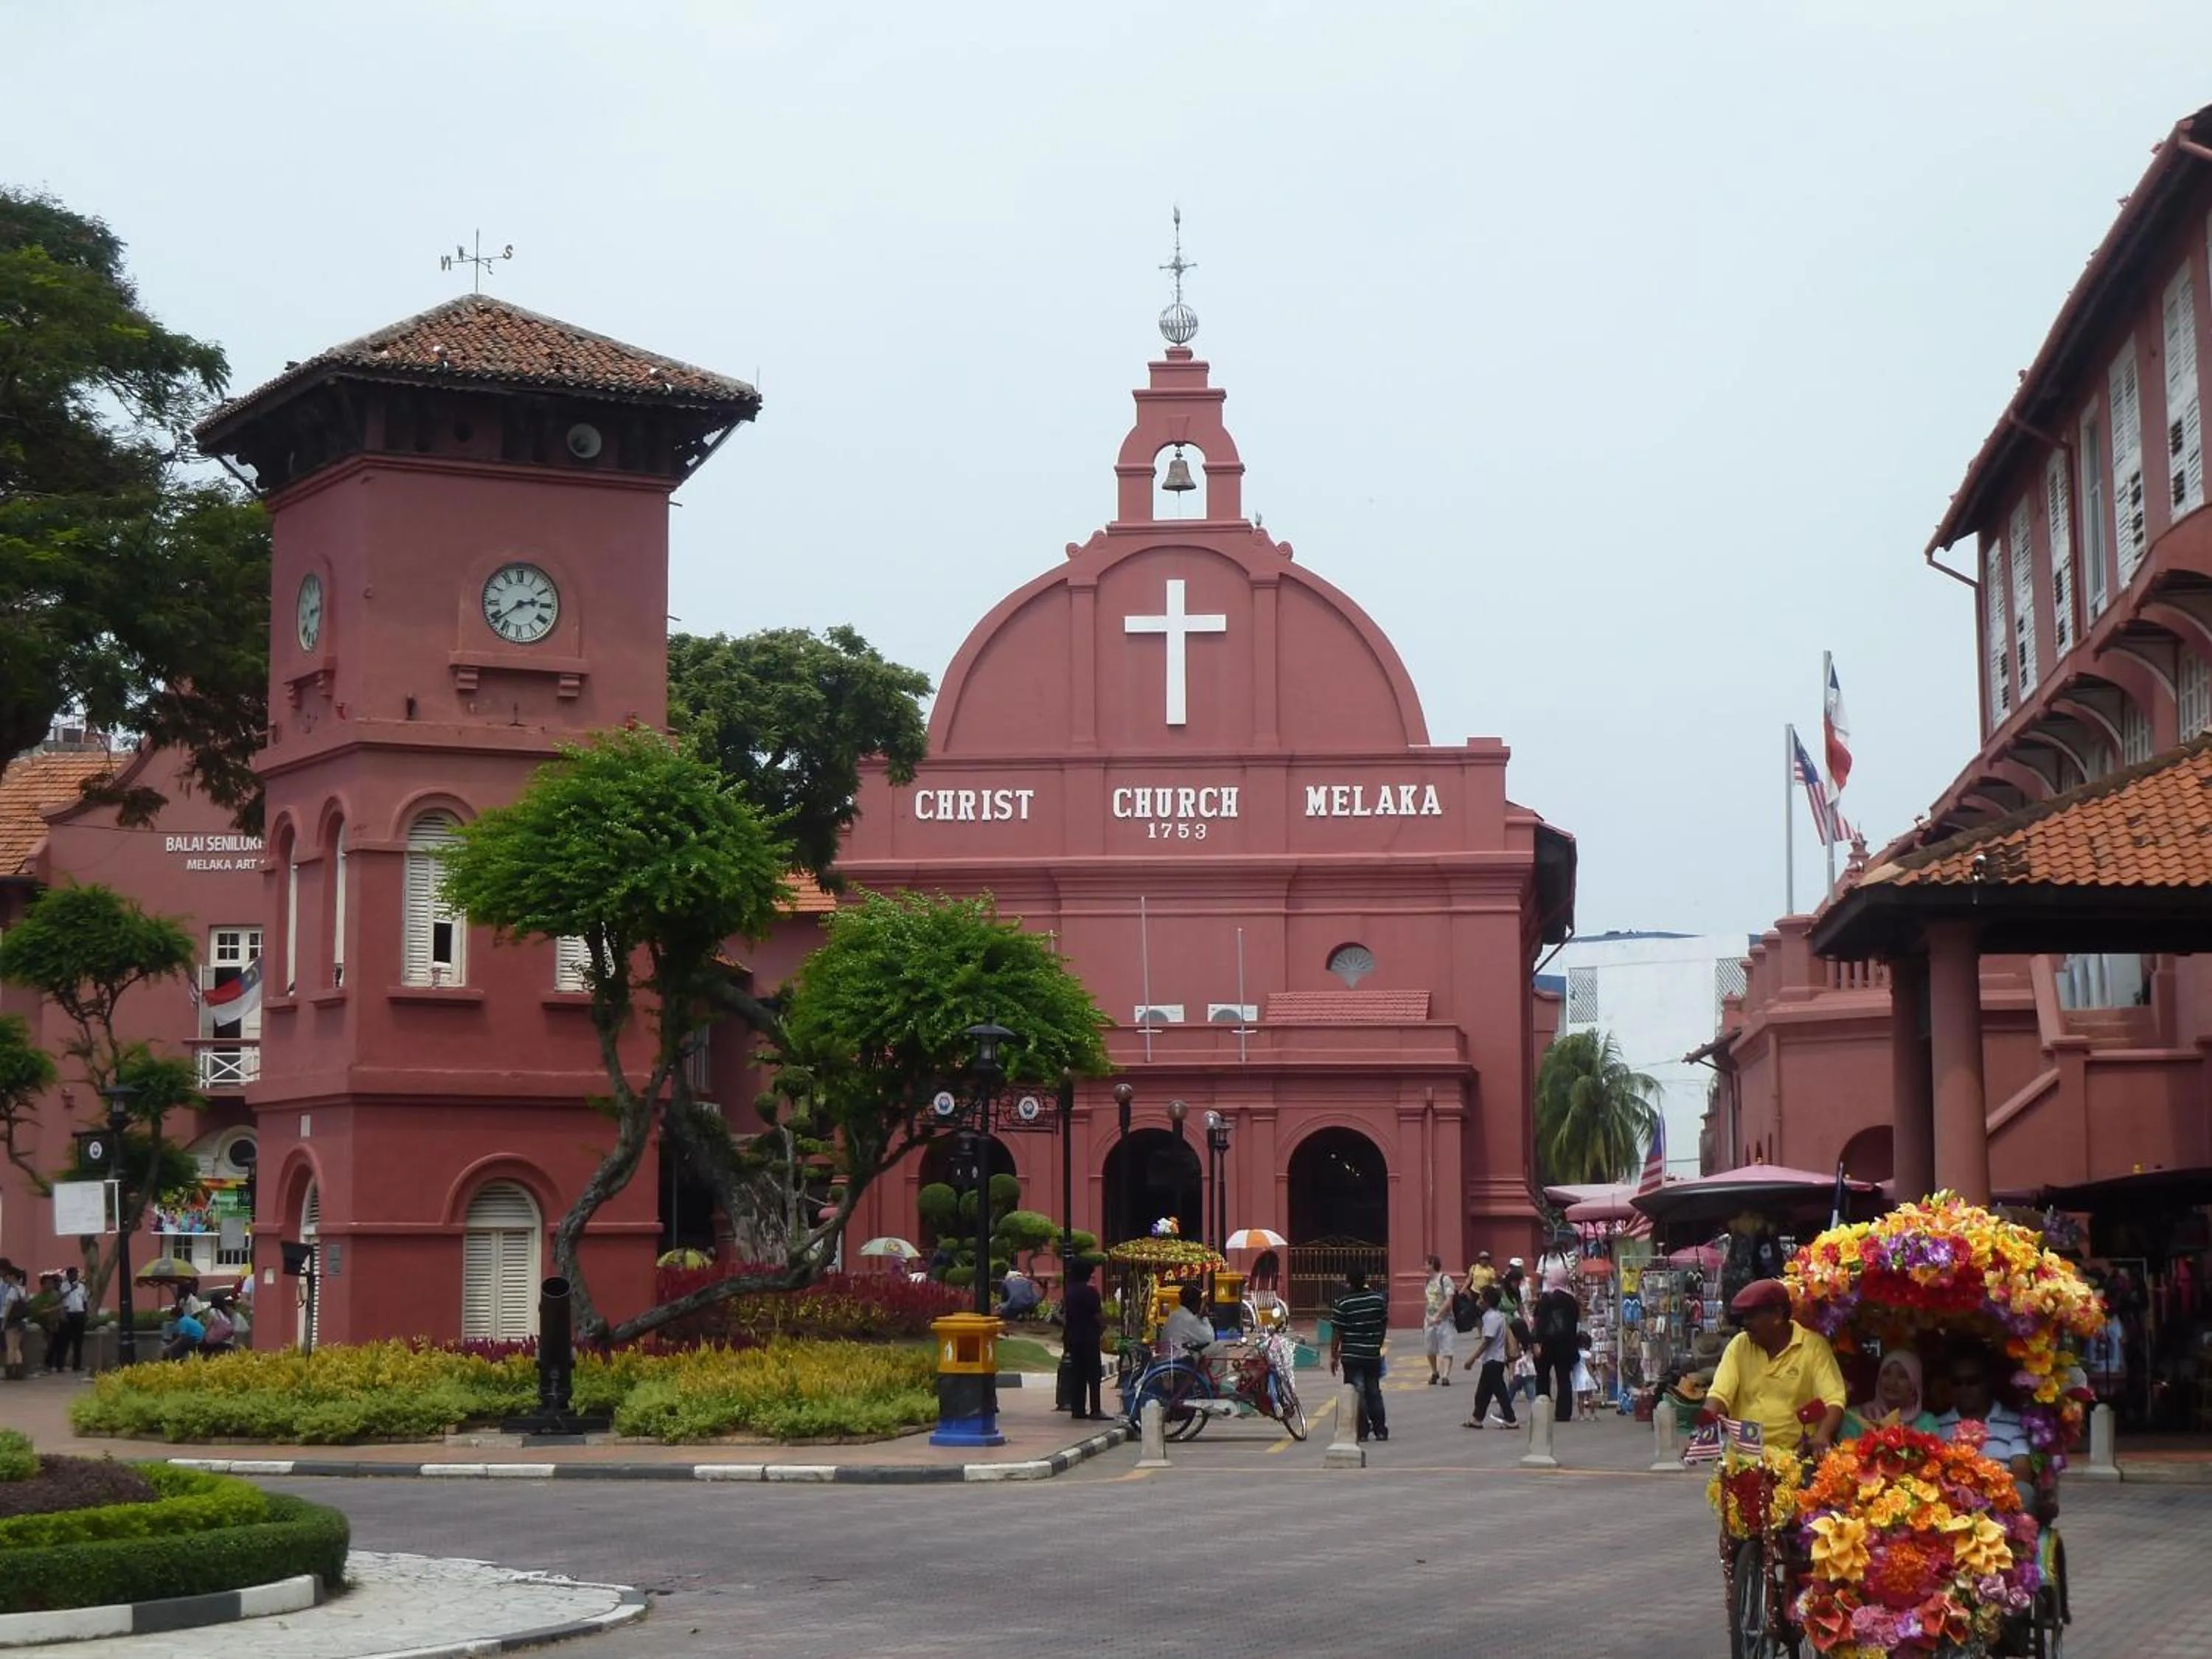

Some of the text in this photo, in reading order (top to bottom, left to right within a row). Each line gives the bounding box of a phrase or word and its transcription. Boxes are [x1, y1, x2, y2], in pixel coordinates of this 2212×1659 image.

[915, 785, 1443, 820] CHRIST CHURCH MELAKA
[1148, 822, 1207, 840] 1753
[166, 837, 204, 851] BALAI
[187, 859, 232, 869] MELAKA
[236, 859, 257, 869] ART
